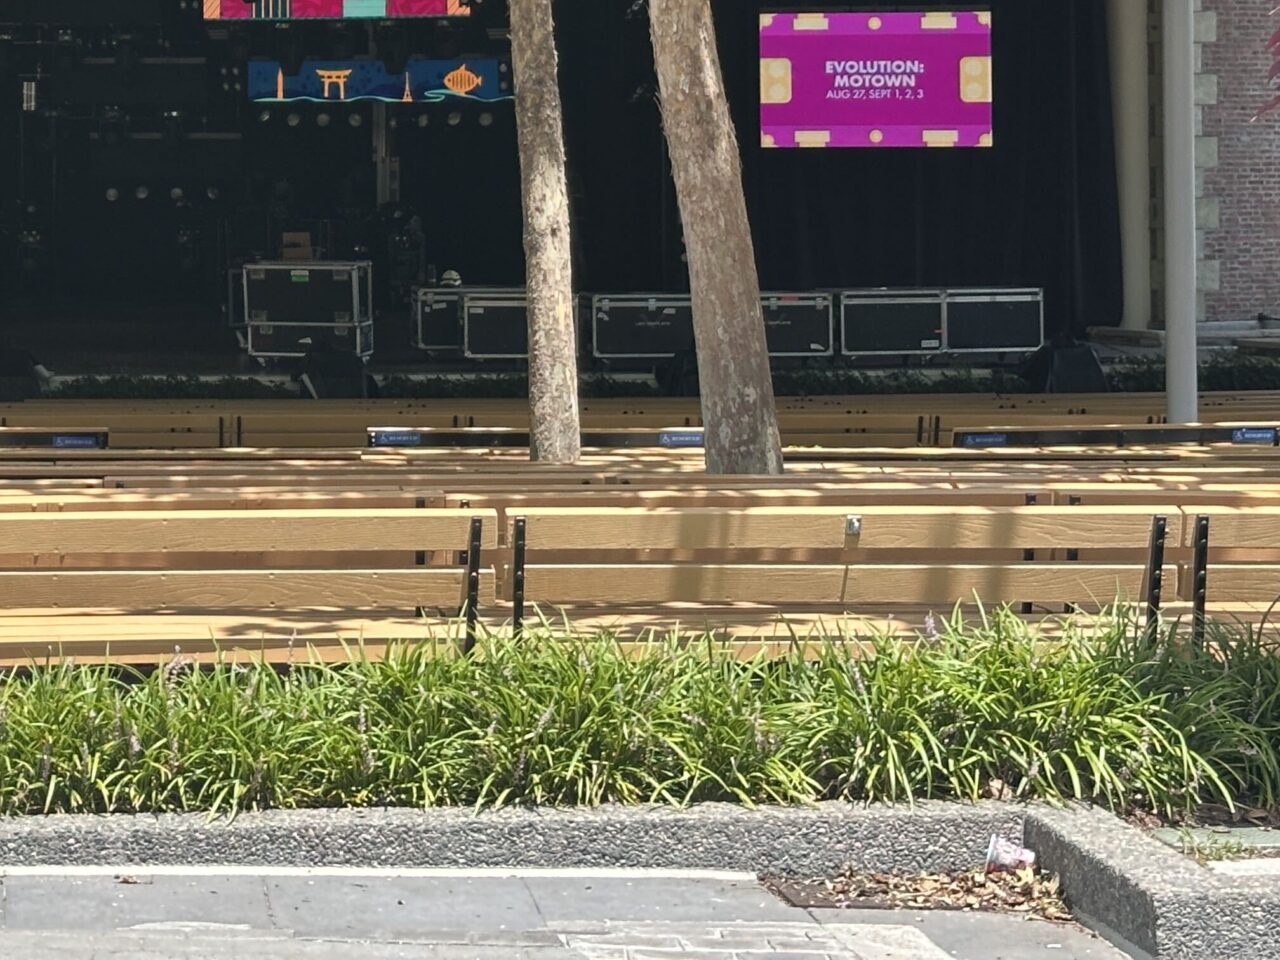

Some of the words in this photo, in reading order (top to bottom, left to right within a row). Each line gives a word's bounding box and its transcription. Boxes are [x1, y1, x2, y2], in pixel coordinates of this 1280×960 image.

[825, 60, 925, 74] EVOLUTION:
[834, 74, 916, 88] MOTOWN
[825, 89, 851, 99] AUG
[852, 89, 867, 100] 27,
[869, 89, 892, 99] SEPT
[894, 89, 902, 100] 1,
[905, 89, 914, 100] 2,
[916, 89, 924, 99] 3
